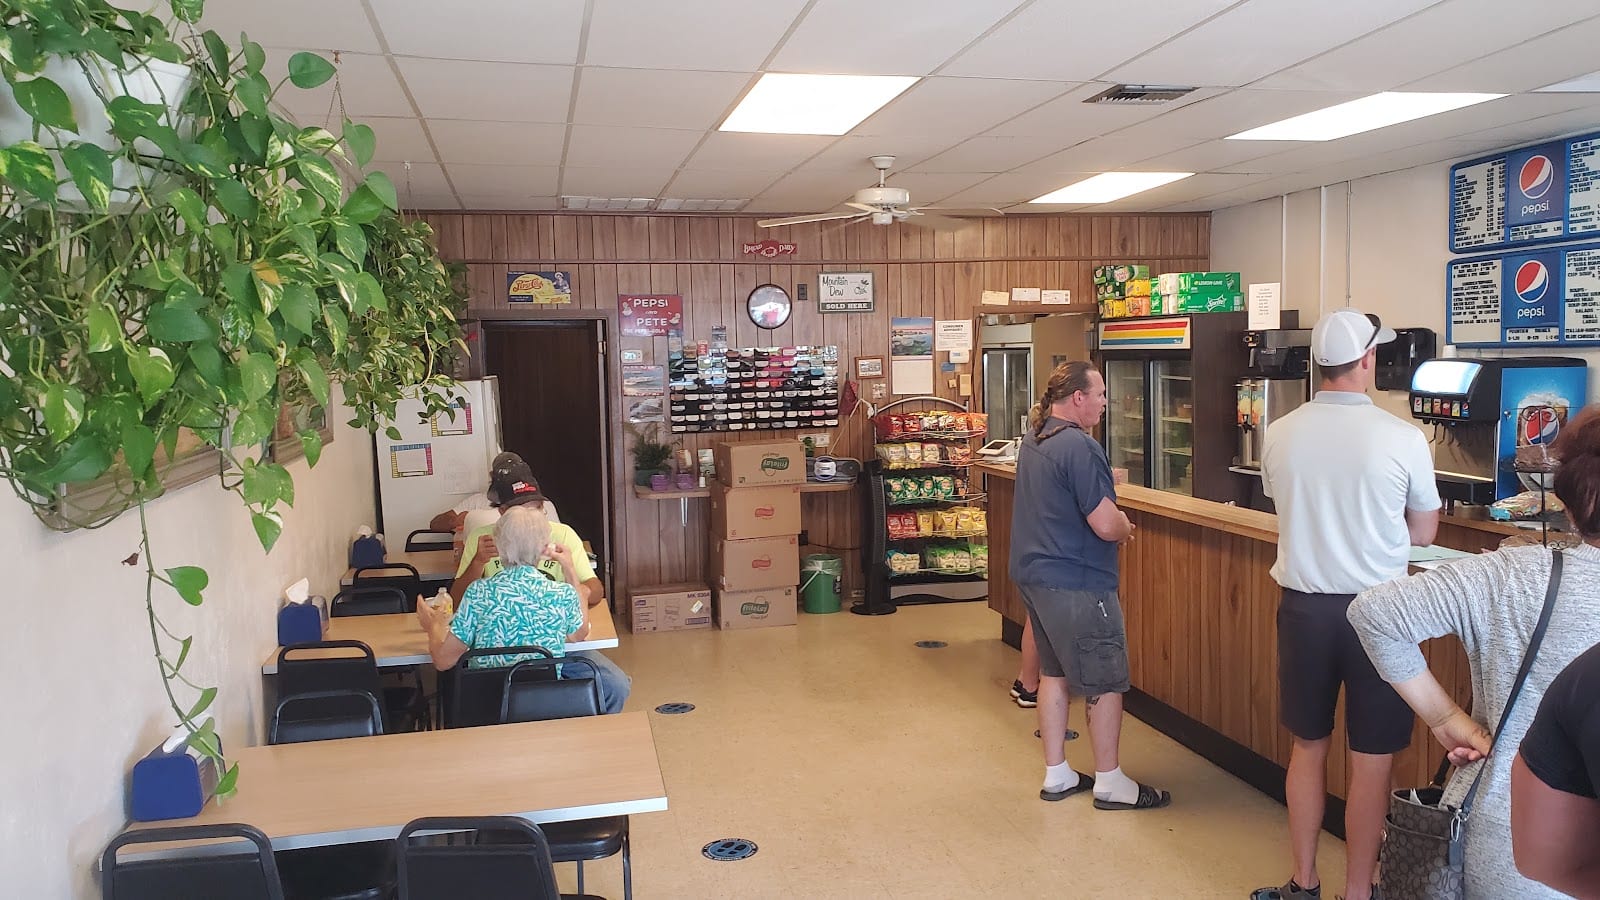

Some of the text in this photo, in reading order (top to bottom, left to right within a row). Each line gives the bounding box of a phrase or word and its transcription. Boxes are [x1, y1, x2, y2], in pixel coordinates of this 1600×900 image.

[1521, 200, 1549, 217] pepsi
[822, 276, 848, 286] Mountain
[829, 286, 844, 296] Dew
[633, 298, 668, 308] PEPSI
[1517, 305, 1546, 320] pepsi
[636, 318, 668, 327] PETE
[543, 560, 556, 569] OF
